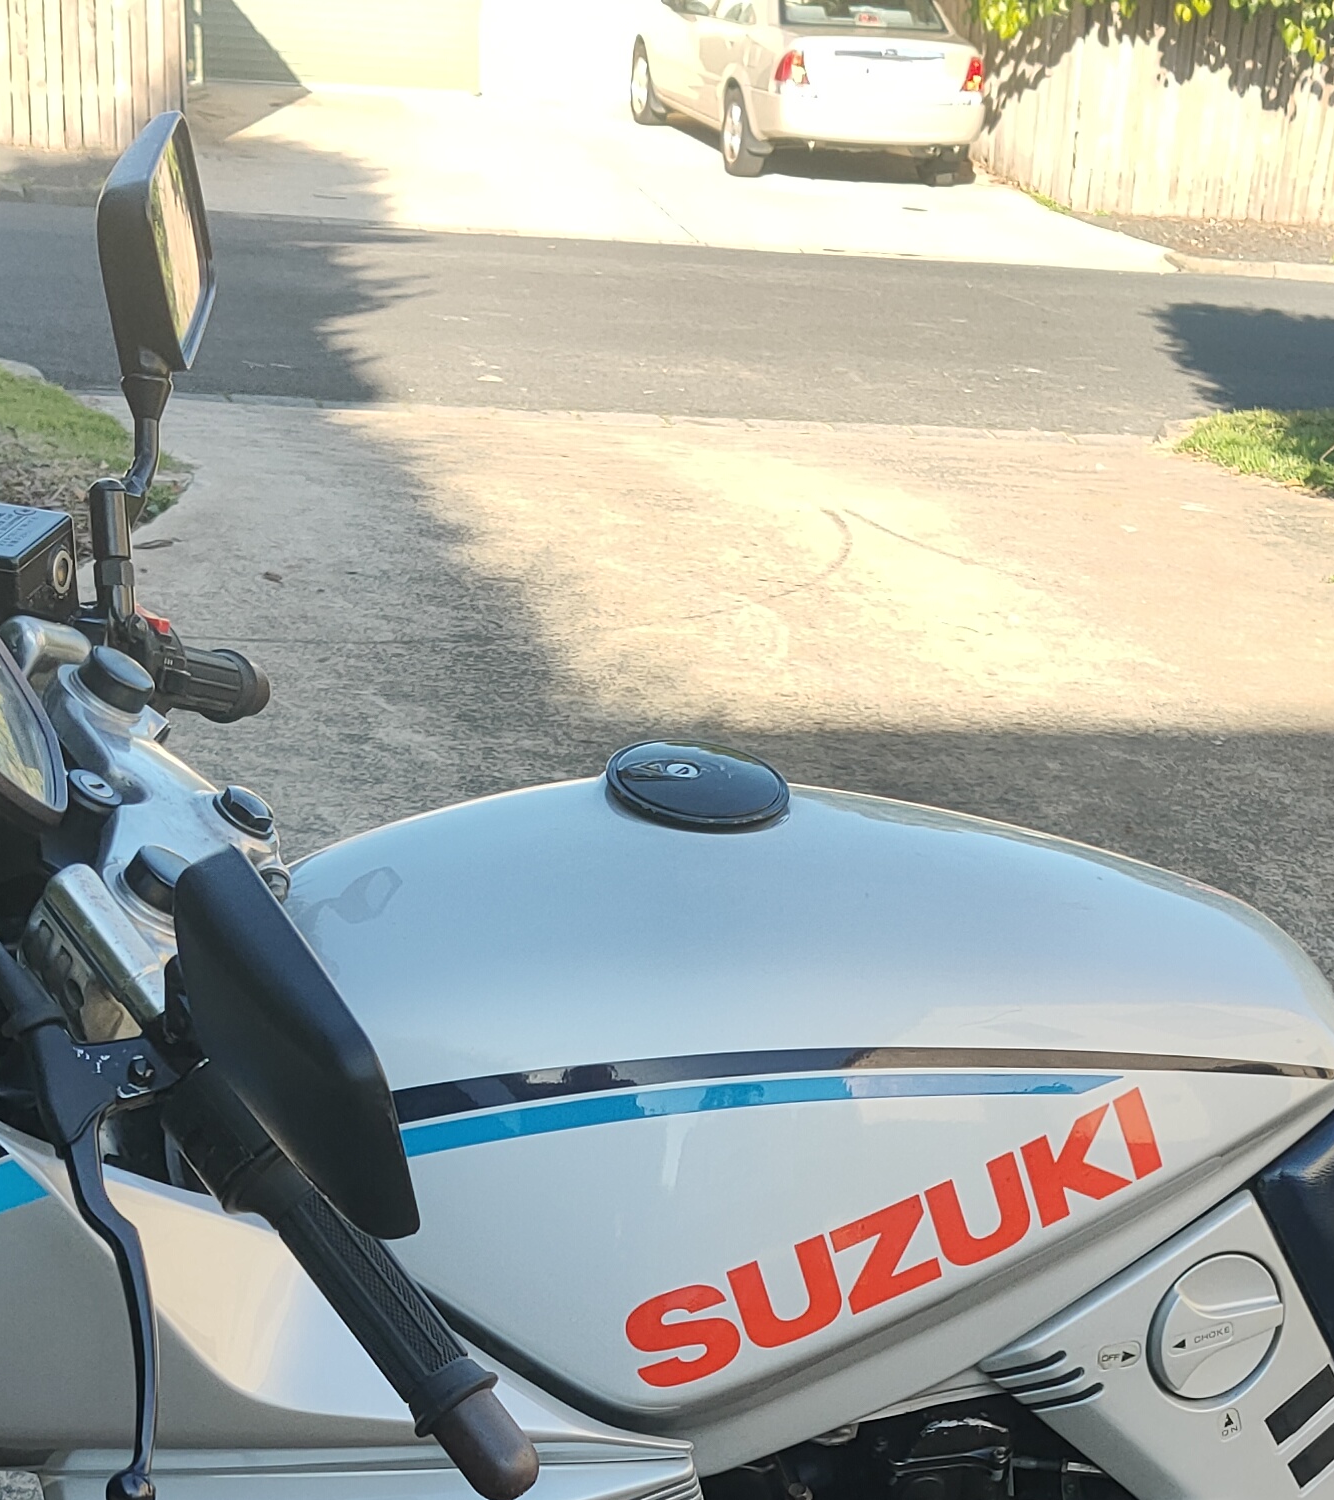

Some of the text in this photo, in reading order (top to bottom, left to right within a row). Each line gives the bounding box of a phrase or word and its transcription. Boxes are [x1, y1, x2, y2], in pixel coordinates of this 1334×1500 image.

[625, 1087, 1162, 1388] SUZUKI
[1193, 1326, 1230, 1344] CHOKE
[1101, 1353, 1120, 1363] OFF
[1221, 1425, 1239, 1437] ON
